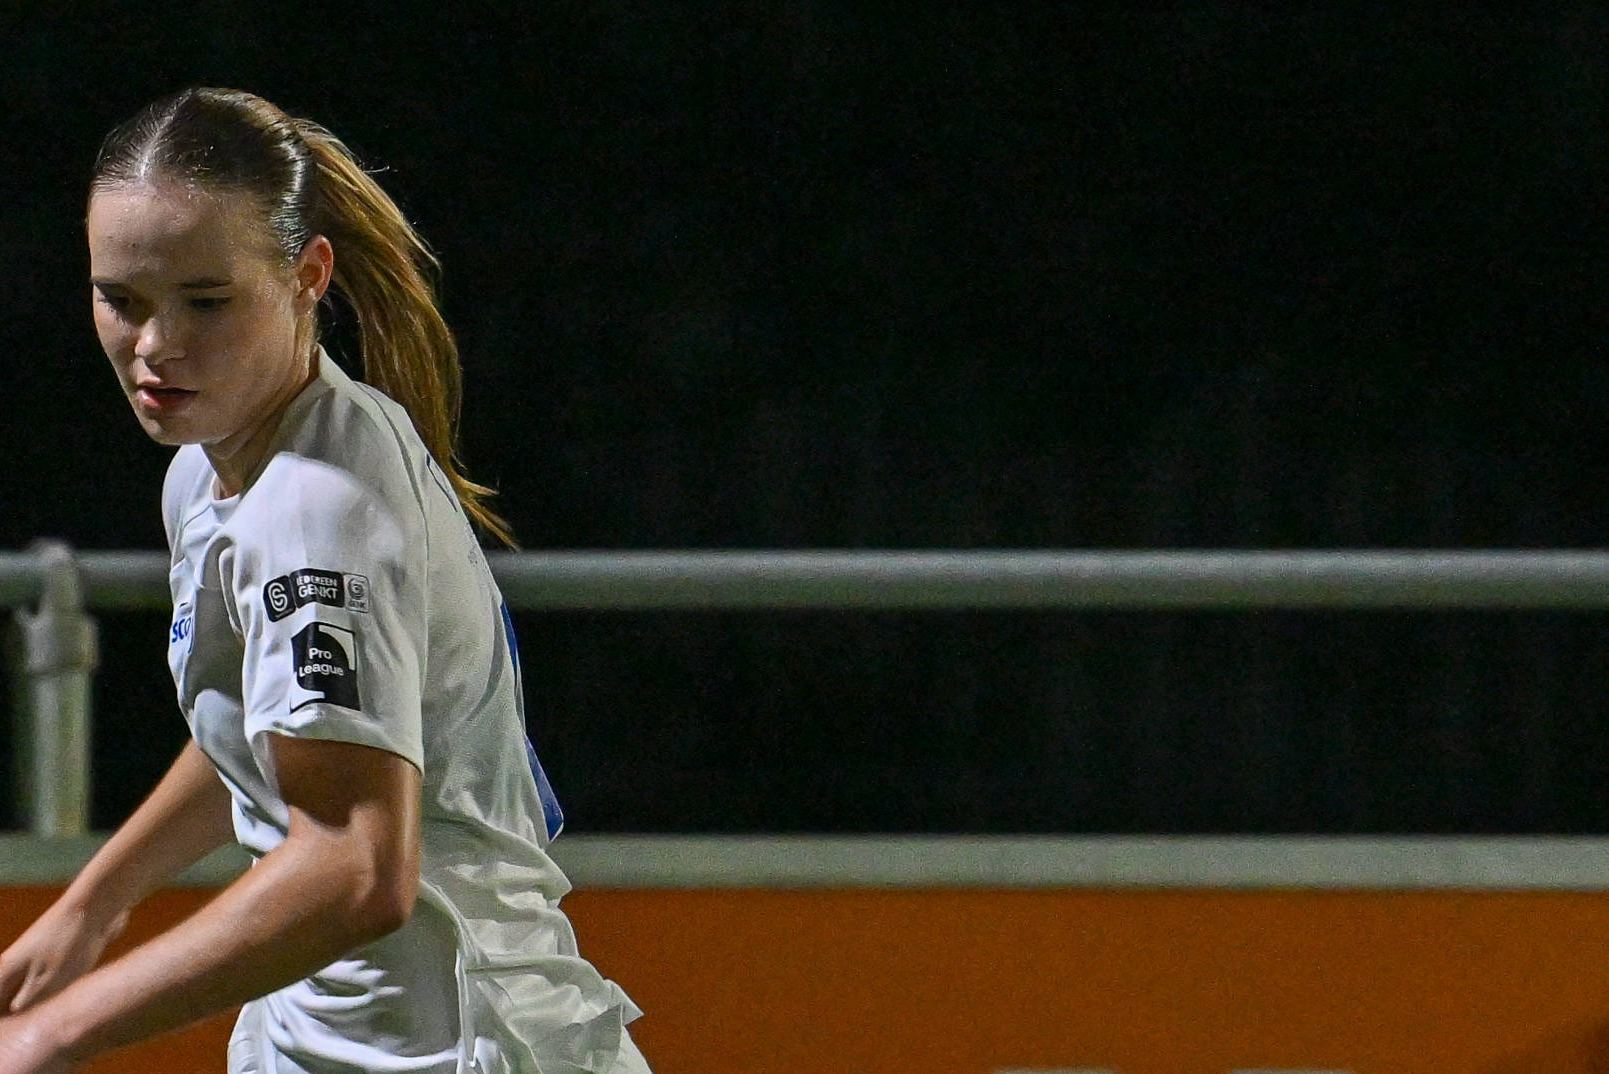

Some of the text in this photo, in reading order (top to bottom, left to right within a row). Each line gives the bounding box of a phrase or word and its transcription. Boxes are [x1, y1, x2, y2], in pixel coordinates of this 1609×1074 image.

[298, 585, 338, 599] GENKT
[308, 646, 332, 660] Pro
[298, 663, 345, 678] League
